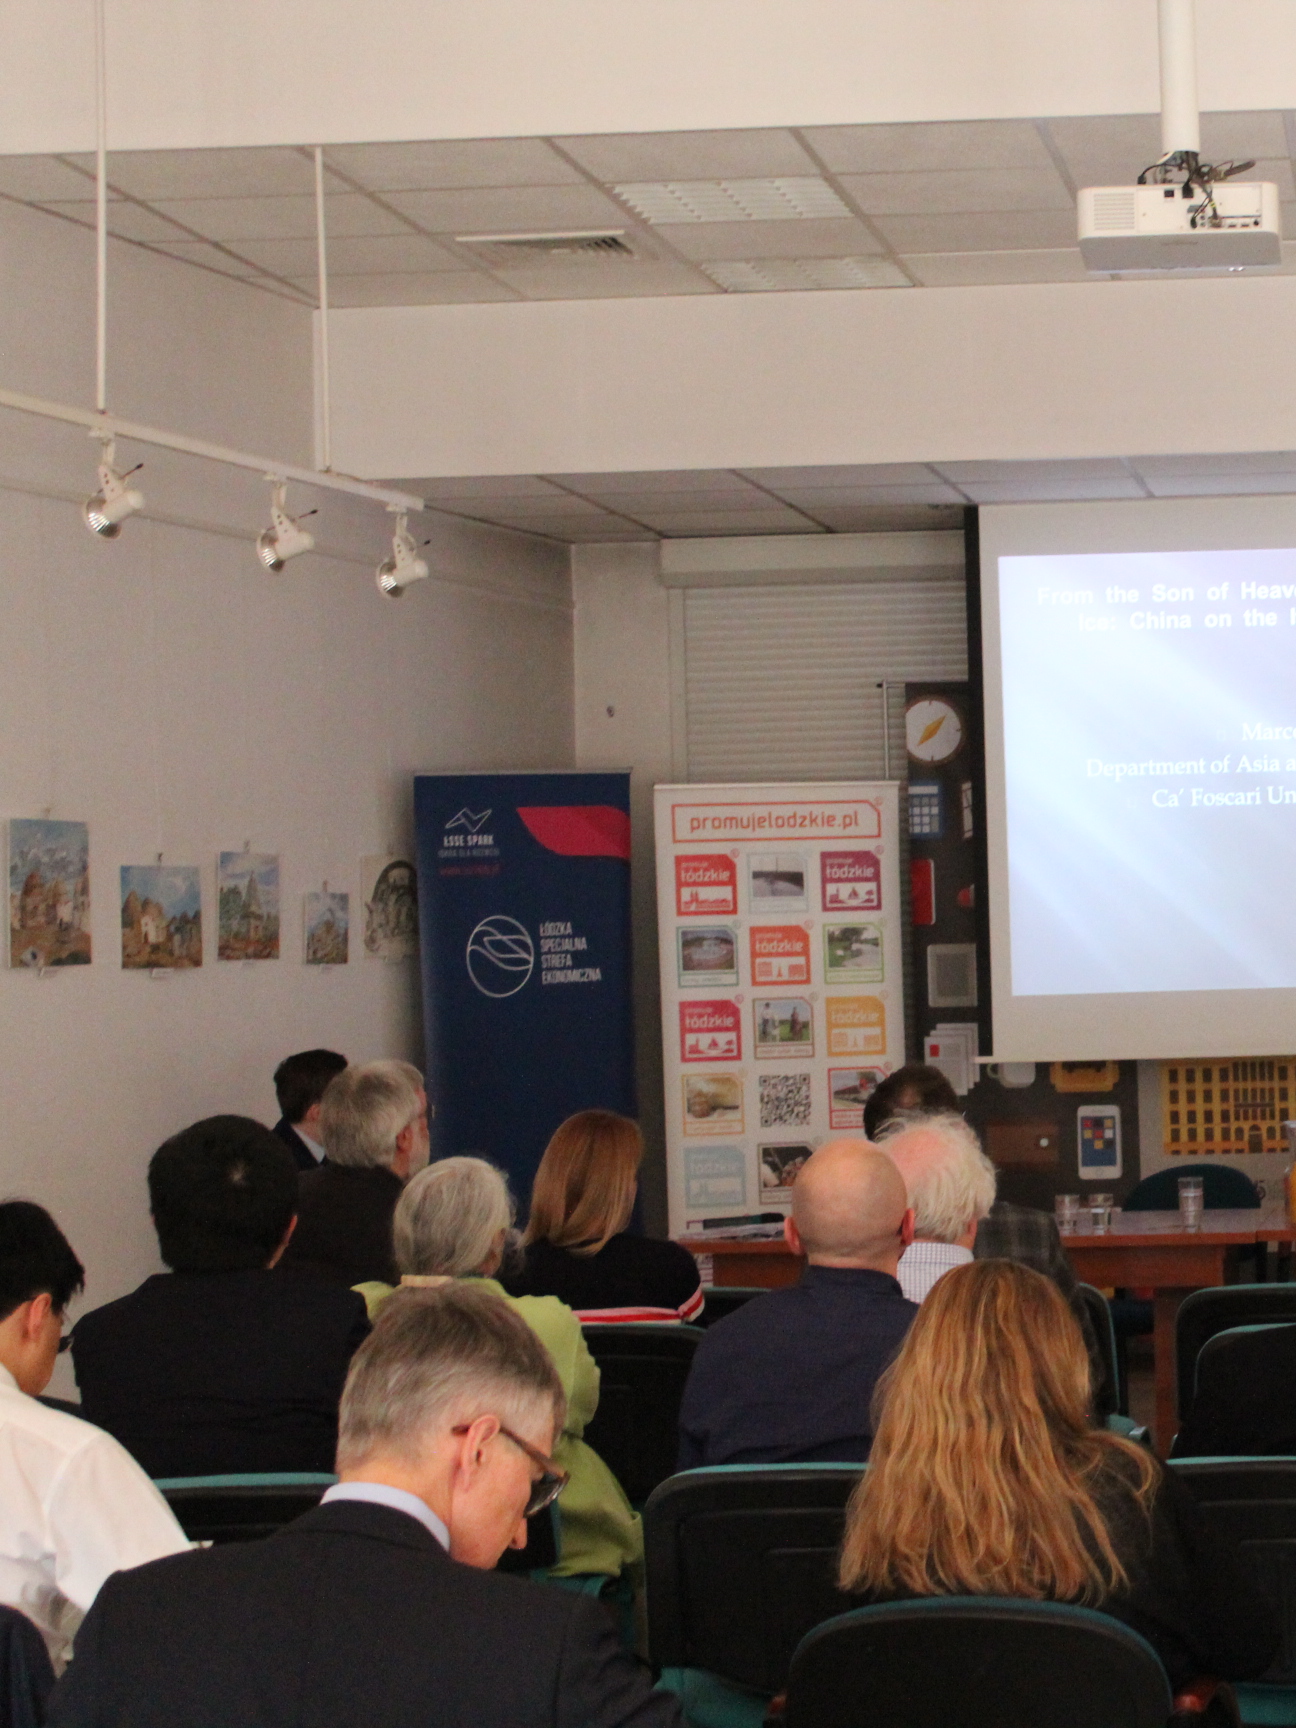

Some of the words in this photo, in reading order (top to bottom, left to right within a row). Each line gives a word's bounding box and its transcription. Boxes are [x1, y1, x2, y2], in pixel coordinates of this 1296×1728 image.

[1037, 587, 1094, 605] From
[1105, 585, 1139, 603] the
[1151, 583, 1194, 602] Son
[1206, 582, 1229, 600] of
[1078, 613, 1117, 631] Ice:
[1129, 611, 1192, 630] China
[1204, 613, 1232, 628] on
[1243, 608, 1277, 627] the
[1086, 756, 1206, 782] Department
[1210, 754, 1231, 774] of
[1235, 755, 1280, 773] Asia
[1191, 787, 1261, 807] Foscari
[690, 810, 859, 833] promujelodzkie.pl
[467, 834, 495, 847] SPARK
[681, 867, 730, 883] łódzkie
[826, 863, 875, 878] łódzkie
[540, 921, 573, 936] ŁÓDZKA
[540, 937, 588, 952] SPECJALNA
[755, 938, 804, 953] łódzkie
[541, 954, 573, 969] STREFA
[542, 969, 602, 985] EKONOMICZNA
[685, 1012, 735, 1029] łódzkie
